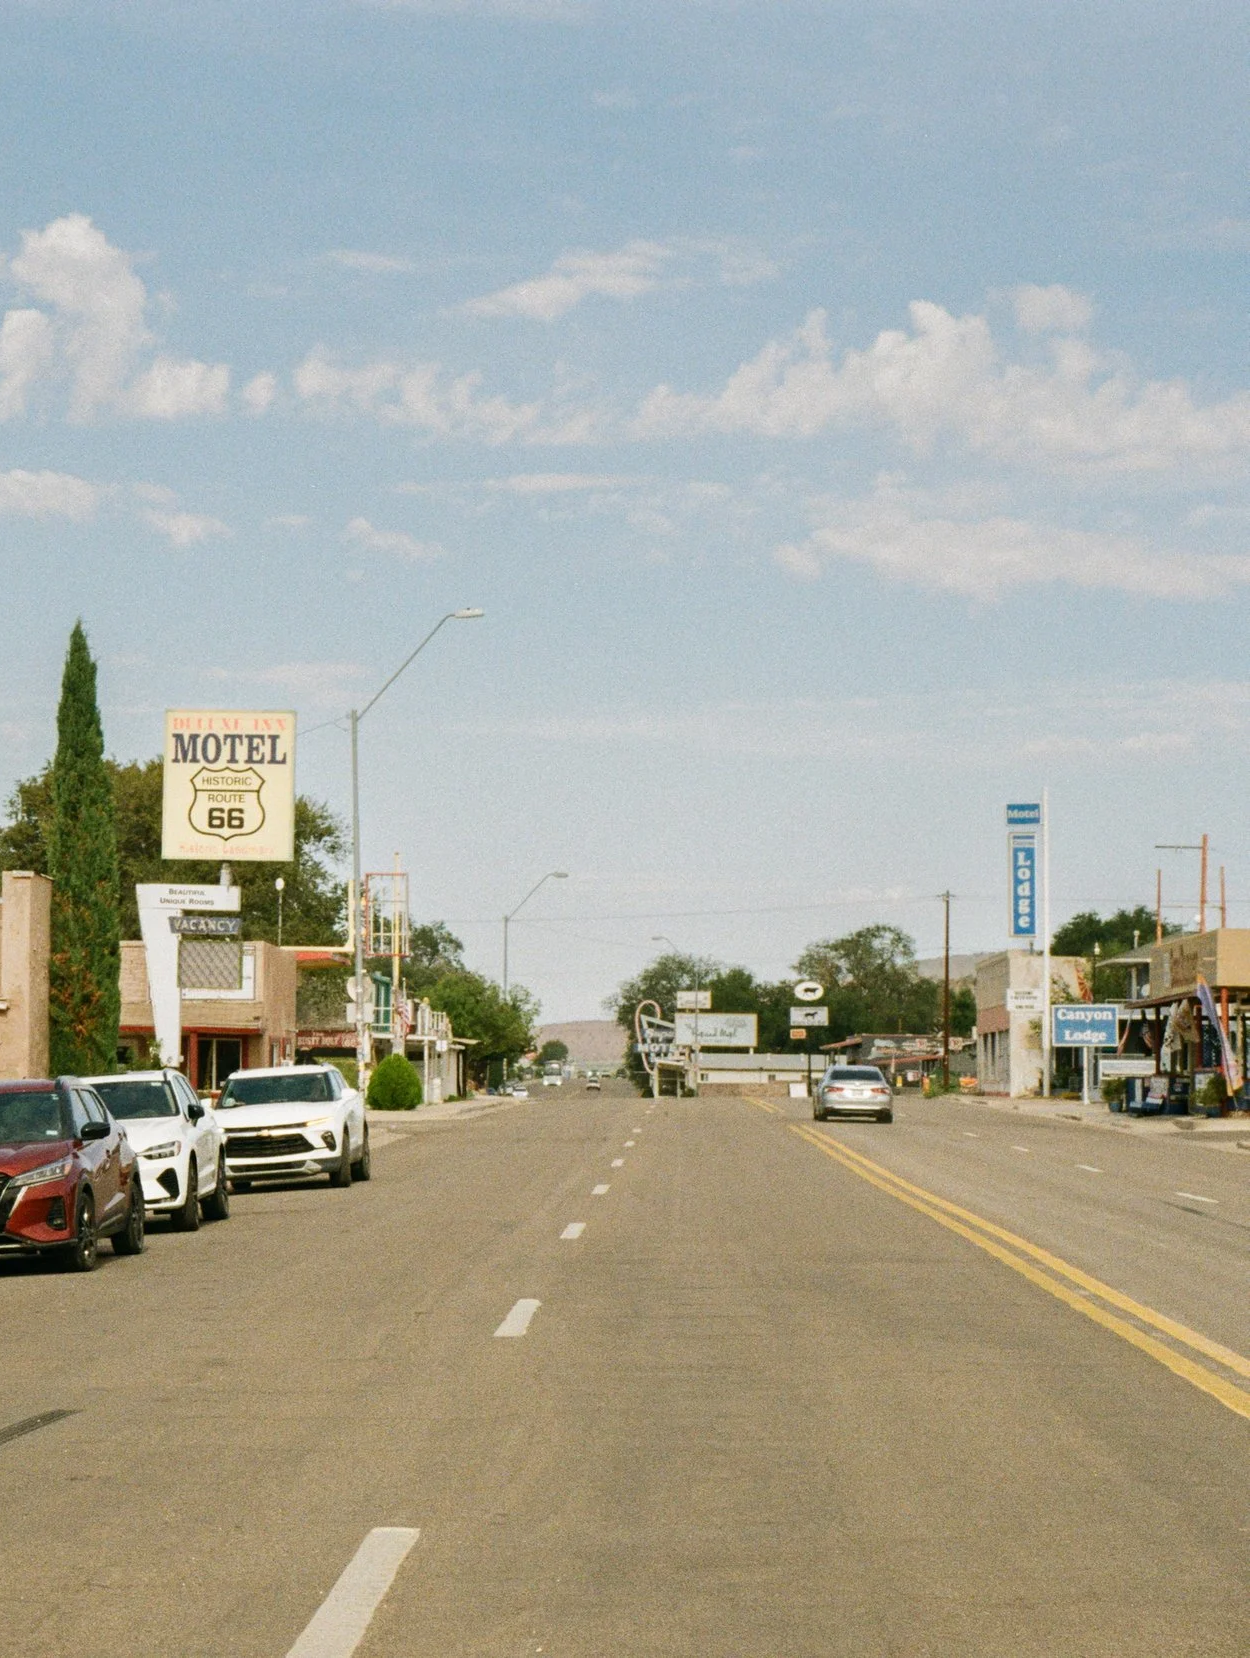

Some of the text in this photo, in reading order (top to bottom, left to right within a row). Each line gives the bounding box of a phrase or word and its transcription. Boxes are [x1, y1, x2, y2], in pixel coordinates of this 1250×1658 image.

[171, 733, 287, 764] MOTEL
[202, 776, 252, 786] HISTORIC
[208, 793, 245, 803] ROUTE
[208, 807, 245, 829] 66
[1008, 809, 1039, 818] Motel
[1017, 850, 1031, 928] Lodge
[175, 920, 237, 932] VACANCY
[1056, 1009, 1113, 1022] Canyon
[1064, 1029, 1108, 1043] Lodge
